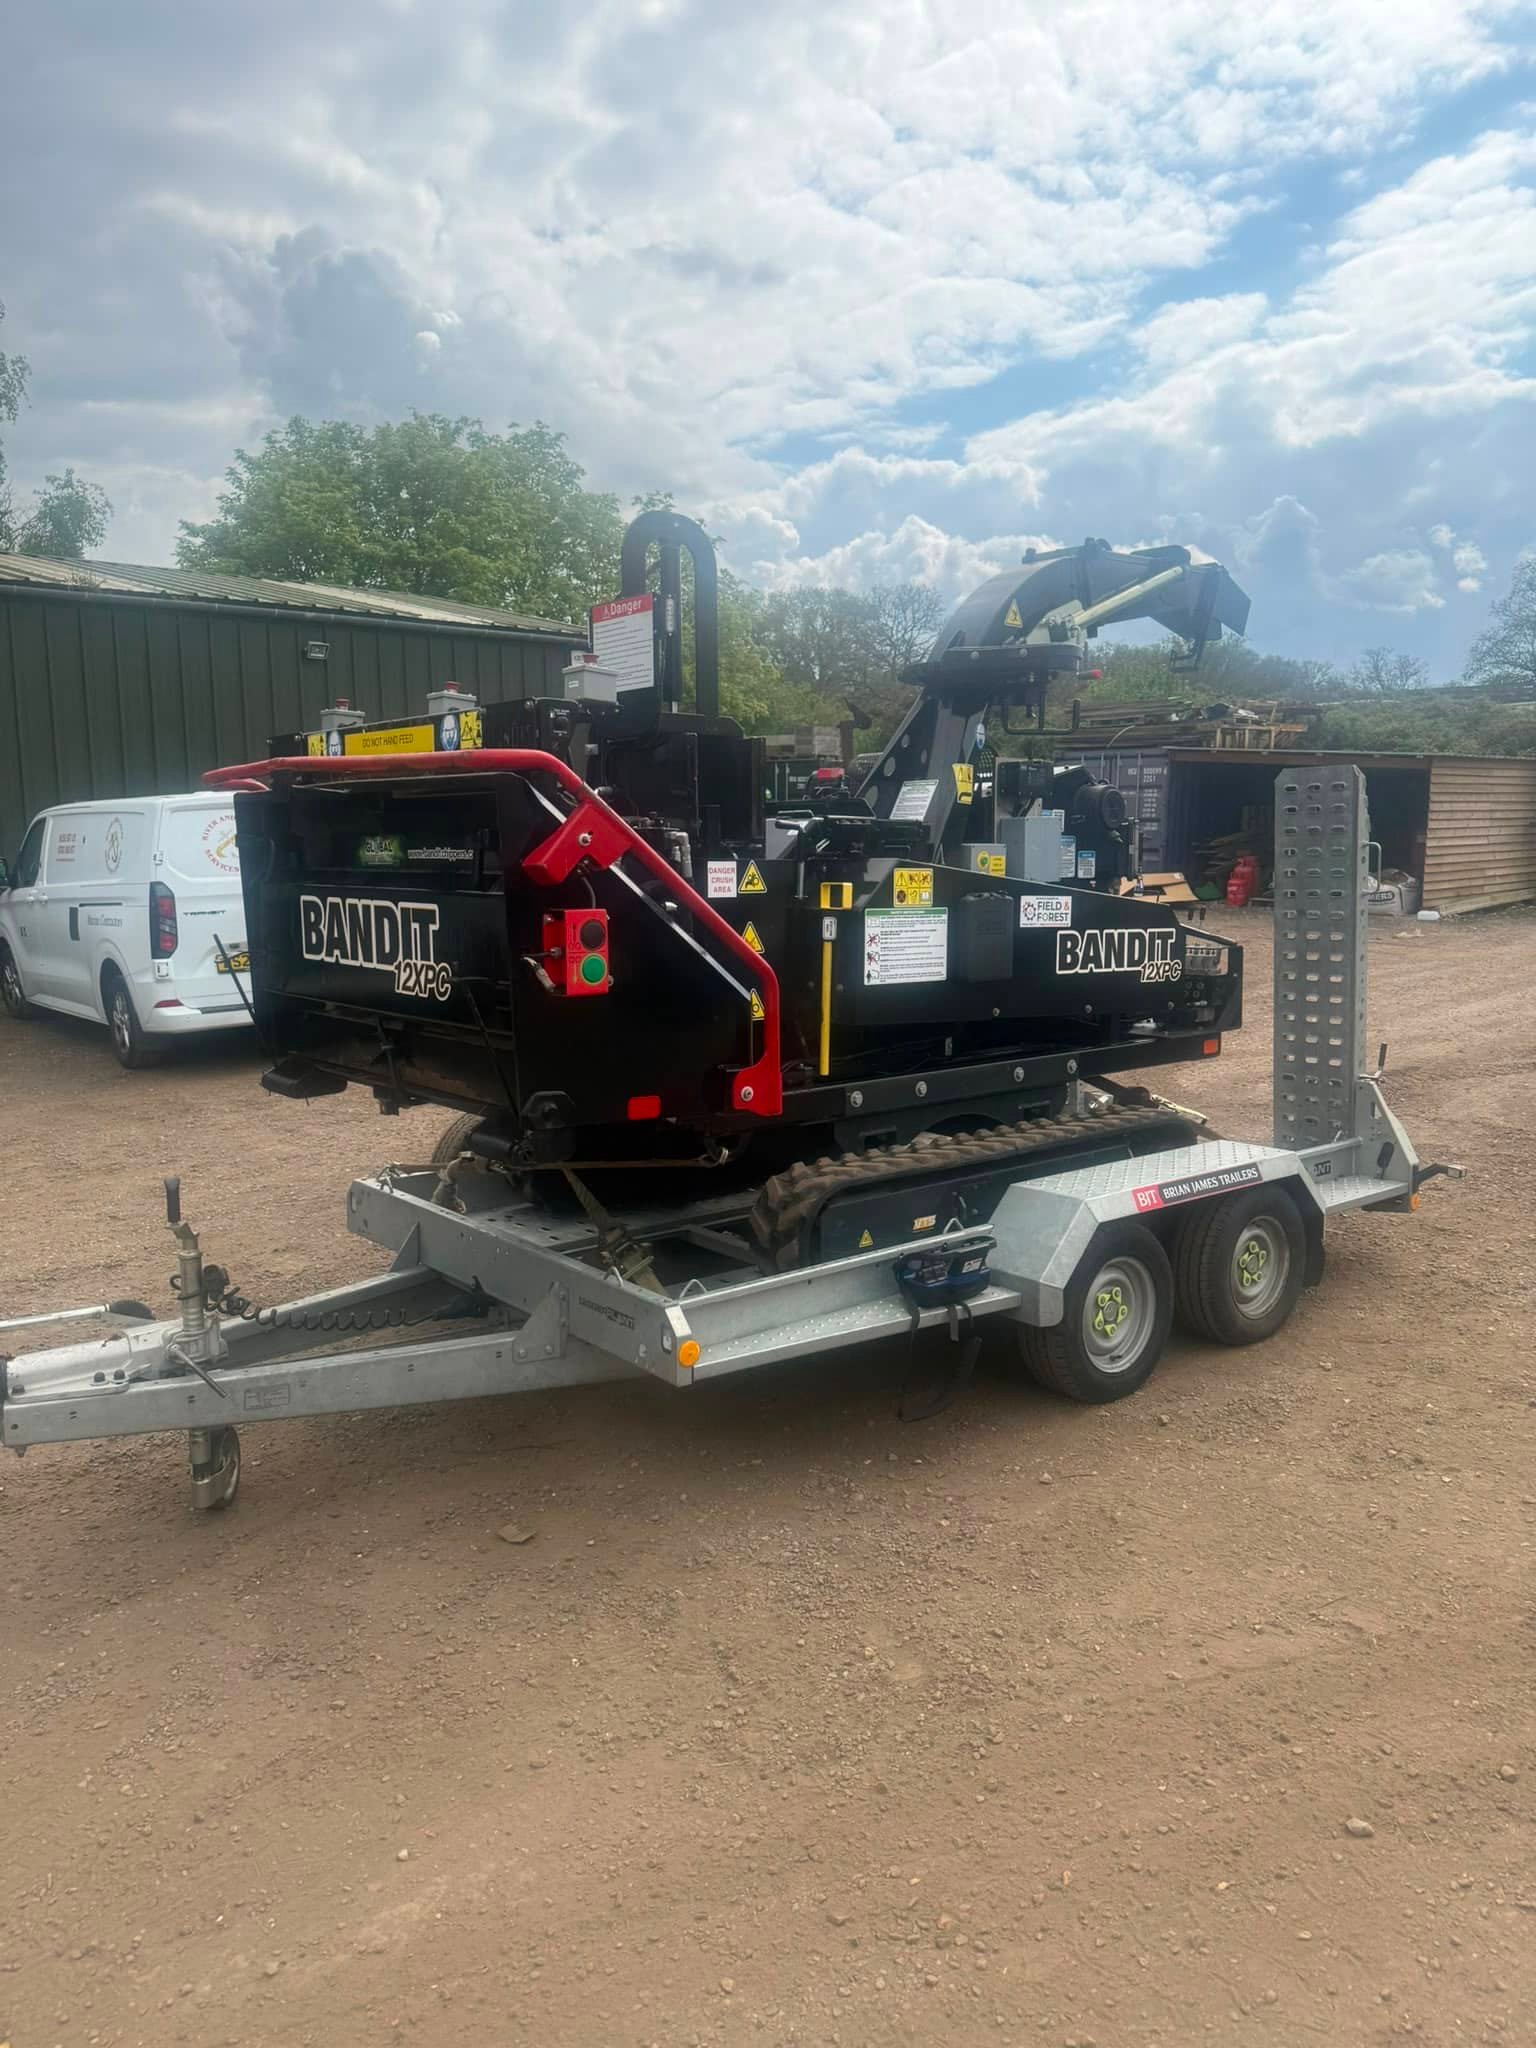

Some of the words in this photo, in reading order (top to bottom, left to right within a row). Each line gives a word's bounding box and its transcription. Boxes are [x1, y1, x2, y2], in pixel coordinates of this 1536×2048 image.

[610, 599, 643, 616] Danger
[371, 736, 382, 747] NOT
[383, 735, 398, 745] HAND
[399, 733, 414, 744] FEED
[202, 819, 219, 841] RIVER
[1037, 901, 1062, 911] FIELD
[1037, 912, 1070, 921] FOREST
[300, 895, 439, 971] BANDIT
[1056, 928, 1176, 975] BANDIT
[395, 959, 452, 1001] 12XPC
[1140, 959, 1182, 983] 12XPC
[1136, 1189, 1158, 1208] BJT
[1162, 1184, 1191, 1199] BRIAN
[1191, 1177, 1219, 1194] JAMES
[1218, 1167, 1259, 1186] TRAILERS
